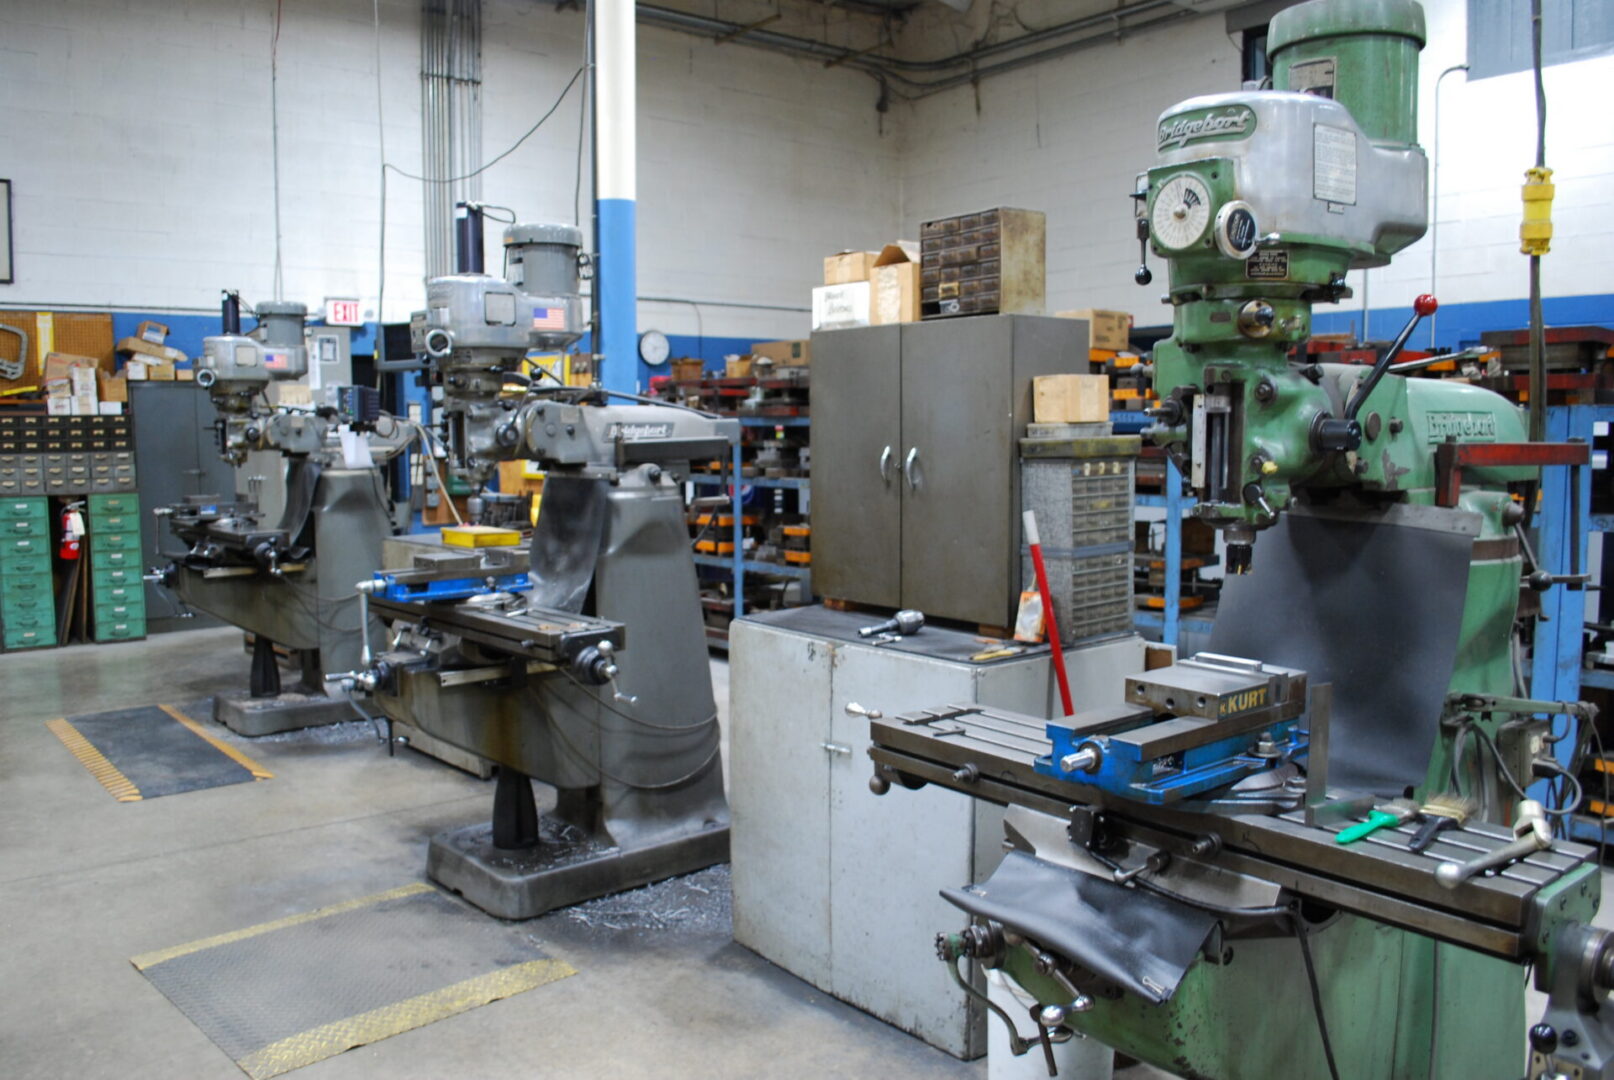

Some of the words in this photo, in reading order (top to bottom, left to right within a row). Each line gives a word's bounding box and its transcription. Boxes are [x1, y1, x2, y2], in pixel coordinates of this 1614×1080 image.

[1159, 110, 1251, 148] Bridgeport
[333, 302, 359, 322] EXIT
[607, 424, 667, 440] Bidgeport
[1228, 688, 1267, 713] KURT
